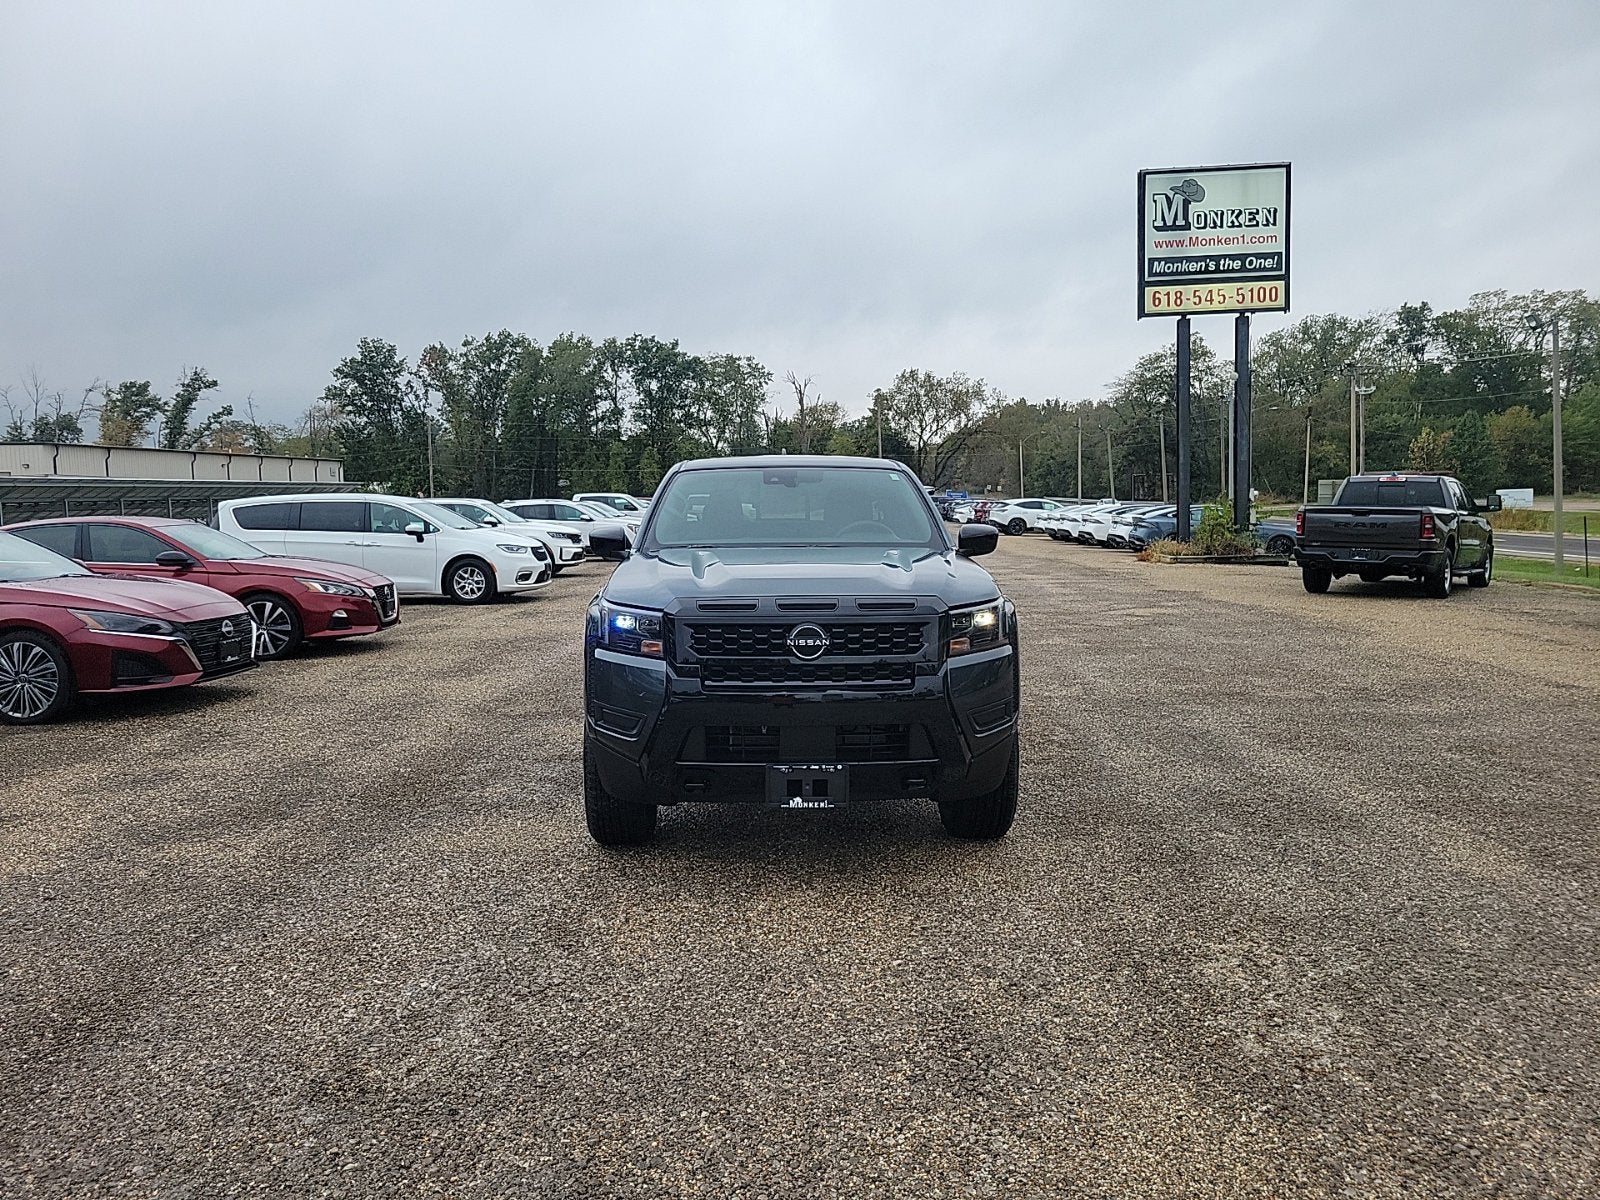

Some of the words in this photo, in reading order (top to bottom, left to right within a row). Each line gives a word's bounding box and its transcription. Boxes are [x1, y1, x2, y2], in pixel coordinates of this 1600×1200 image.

[1152, 193, 1278, 232] MONKEN
[1153, 234, 1278, 249] www.Monken1.com
[1152, 258, 1216, 273] Monken's
[1219, 257, 1242, 270] the
[1245, 255, 1278, 269] One!
[1151, 285, 1279, 308] 618-545-5100
[1333, 521, 1388, 529] RAM
